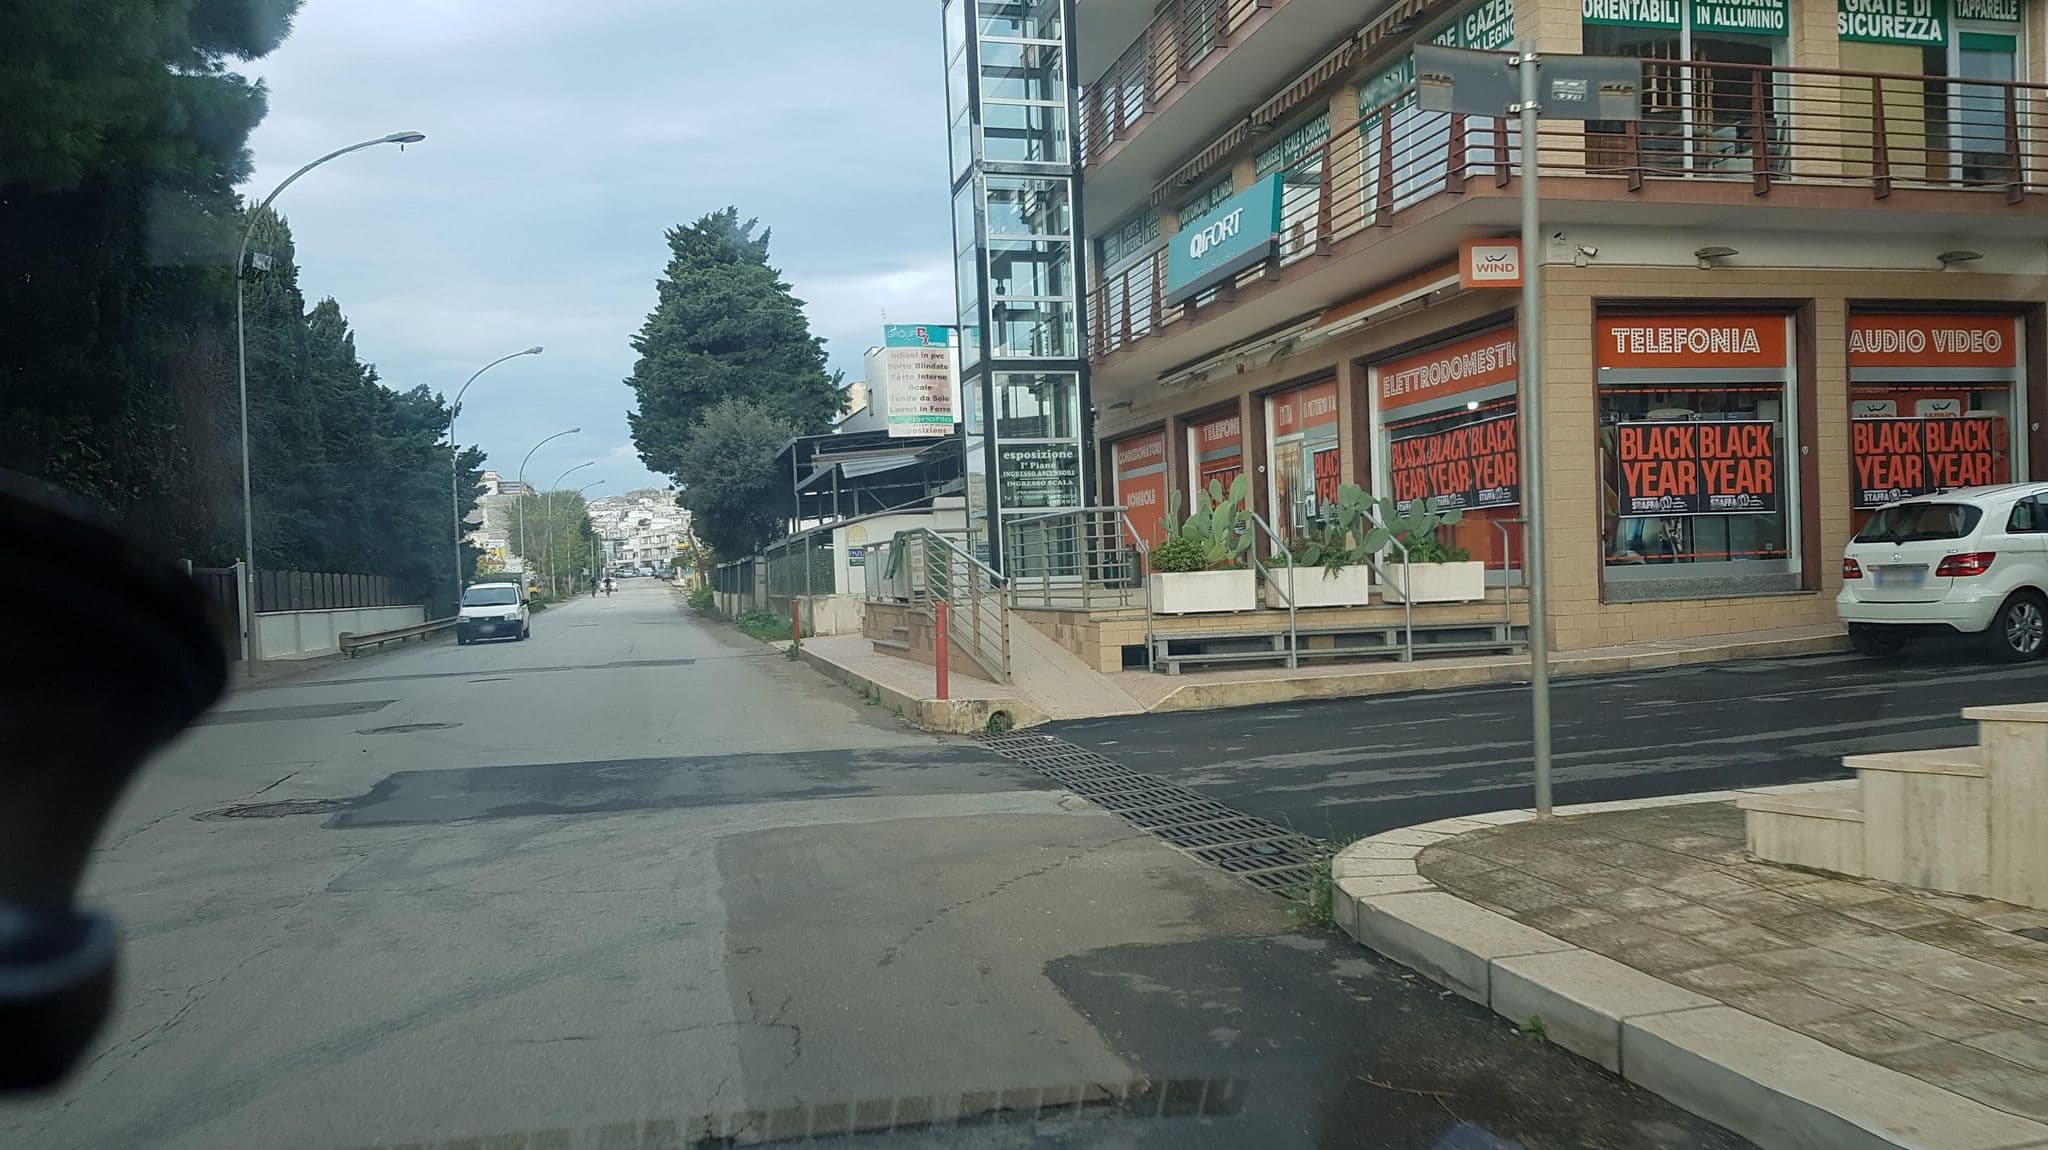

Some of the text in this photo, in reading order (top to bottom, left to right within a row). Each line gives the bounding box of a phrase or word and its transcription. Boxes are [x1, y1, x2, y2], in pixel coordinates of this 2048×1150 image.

[1582, 0, 1679, 24] ORIENTABILI
[1696, 5, 1784, 29] IN ALLUMINIO
[1957, 0, 2017, 20] TAPPARELLE
[1838, 12, 1943, 41] SICUREZZA
[1476, 263, 1515, 273] WIND
[1612, 328, 1760, 353] TELEFONIA
[1850, 329, 2002, 353] AUDIO VIDEO
[931, 353, 945, 361] pvc
[920, 394, 930, 402] da
[932, 394, 950, 402] Sole
[920, 405, 928, 413] in
[1428, 428, 1469, 465] BLACK
[1471, 418, 1516, 457] BLACK
[1620, 426, 1695, 461] BLACK
[1700, 424, 1771, 459] BLACK
[1853, 422, 1921, 454] BLACK
[1925, 420, 1991, 452] BLACK
[1003, 449, 1073, 461] esposizione
[1315, 450, 1339, 479] BLAC
[1392, 439, 1426, 470] BLACK
[1927, 452, 1992, 487] YEAR
[1393, 467, 1428, 501] YEAR
[1429, 460, 1470, 496] YEAR
[1472, 452, 1517, 490] YEAR
[1622, 460, 1696, 497] YEAR
[1701, 458, 1774, 495] YEAR
[1855, 454, 1922, 490] YEAR
[1863, 493, 1889, 502] STAFFA
